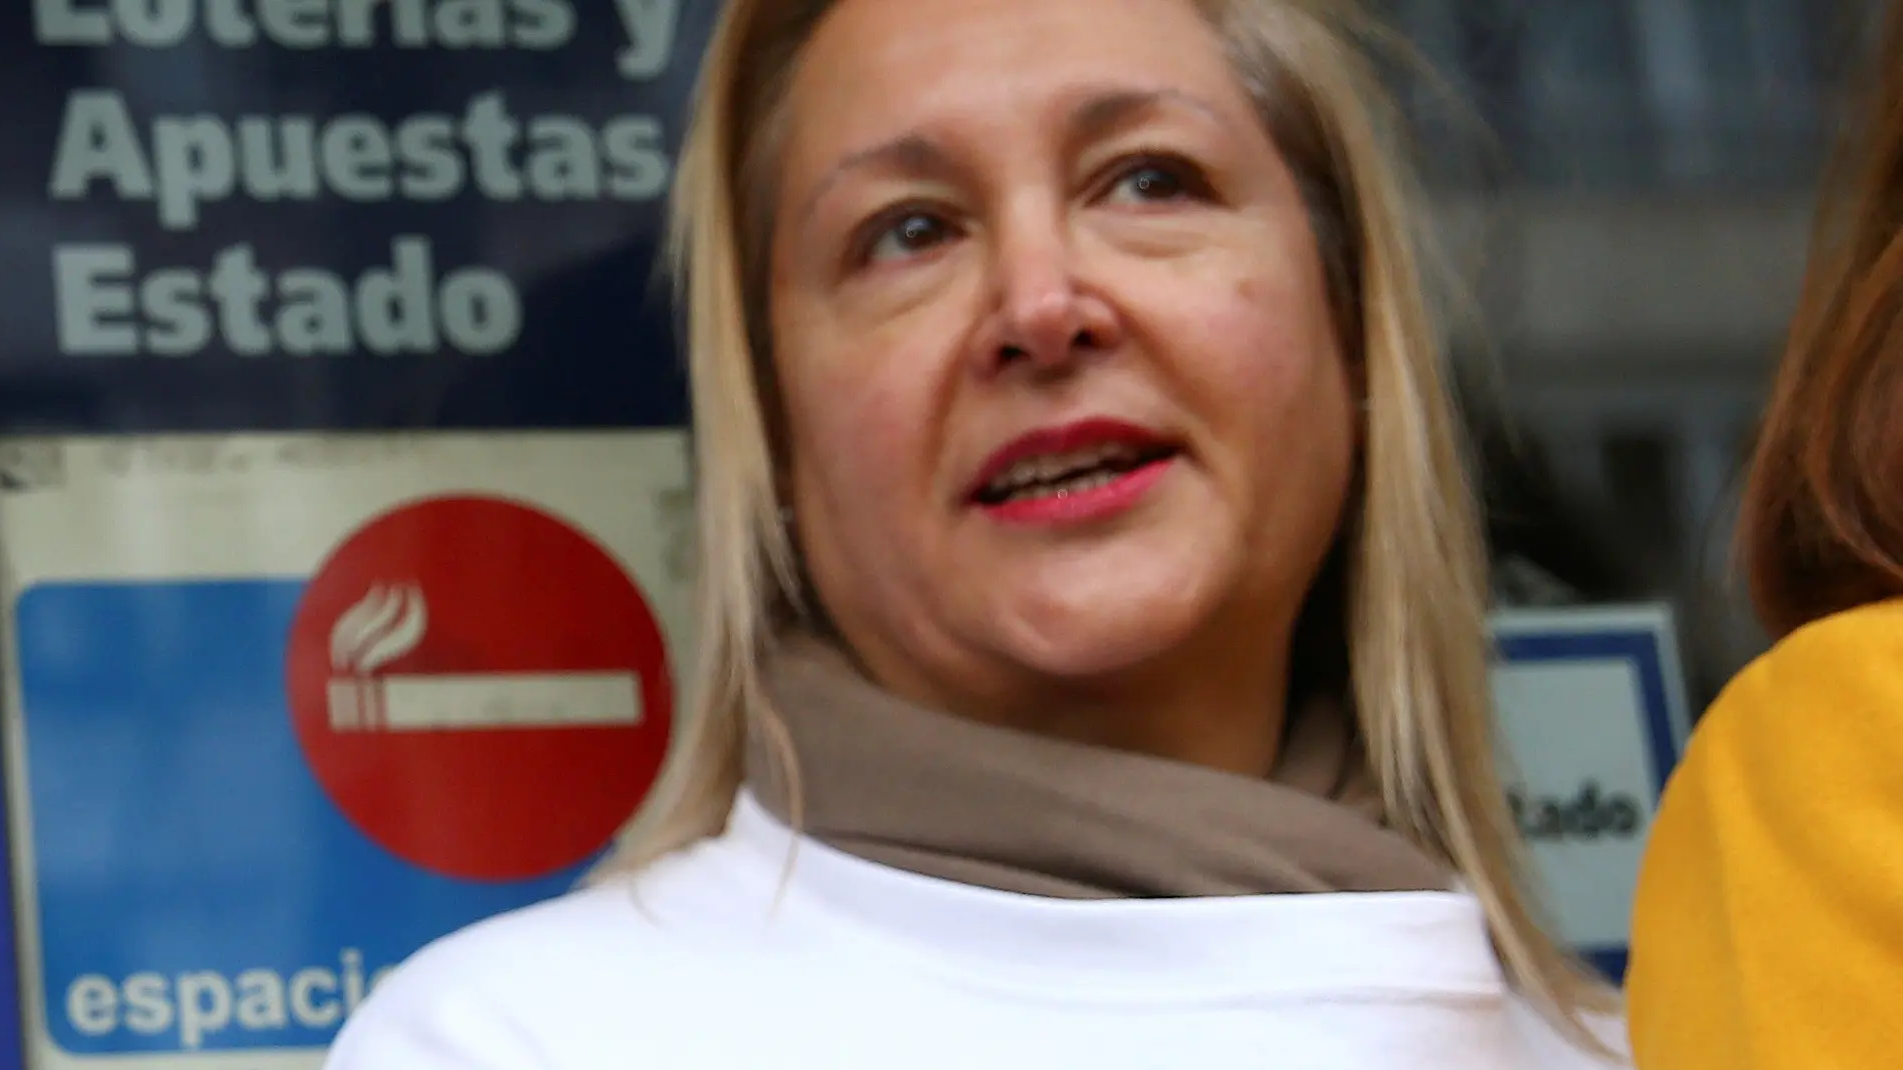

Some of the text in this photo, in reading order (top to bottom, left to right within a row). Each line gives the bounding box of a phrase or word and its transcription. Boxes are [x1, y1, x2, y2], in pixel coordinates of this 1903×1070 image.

[49, 89, 671, 230] Apuestas
[50, 235, 522, 356] Estado
[66, 950, 395, 1048] espaci
